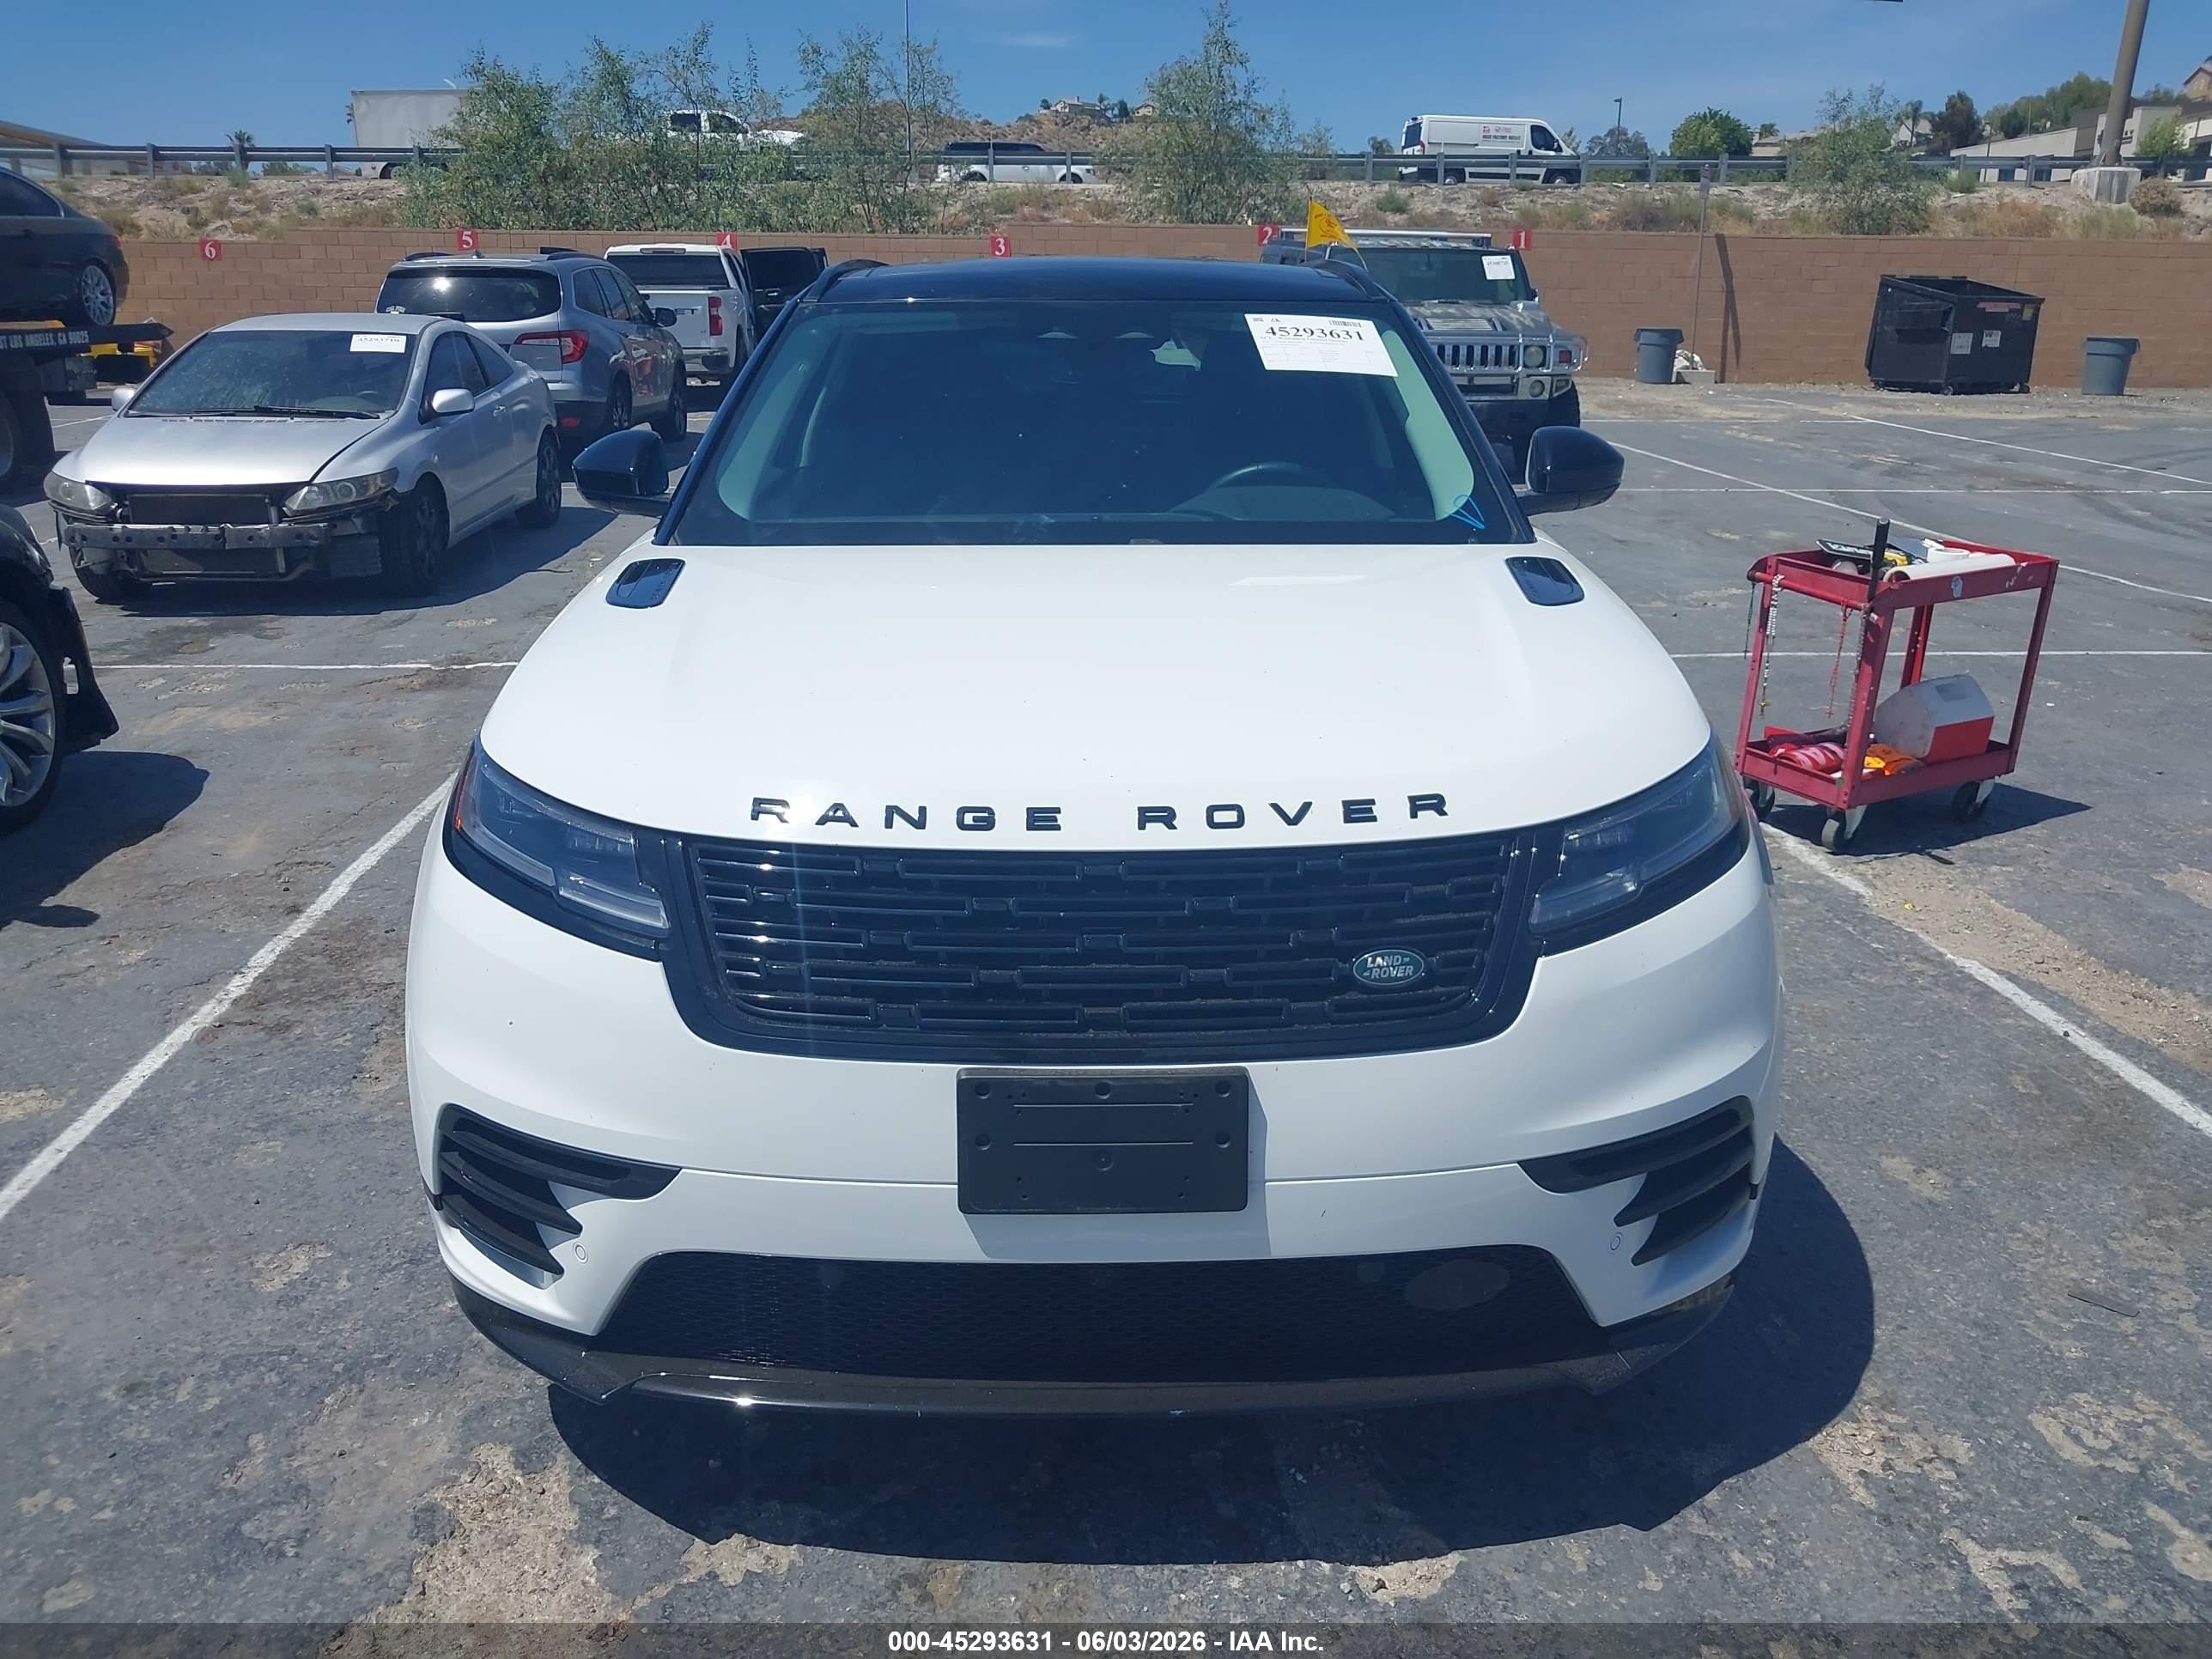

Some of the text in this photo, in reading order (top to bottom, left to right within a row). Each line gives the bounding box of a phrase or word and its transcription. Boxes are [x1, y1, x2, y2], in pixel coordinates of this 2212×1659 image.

[462, 231, 473, 248] 5
[1262, 227, 1273, 245] 2
[1518, 231, 1526, 249] 1
[205, 240, 216, 258] 6
[995, 238, 1006, 256] 3
[9, 334, 23, 349] LOS
[26, 332, 57, 347] ANGELES,
[58, 332, 68, 345] CA
[1265, 325, 1364, 341] 45293631
[750, 793, 1449, 832] RANGE ROVER
[1367, 955, 1402, 968] LAND
[1371, 965, 1414, 979] ROVER
